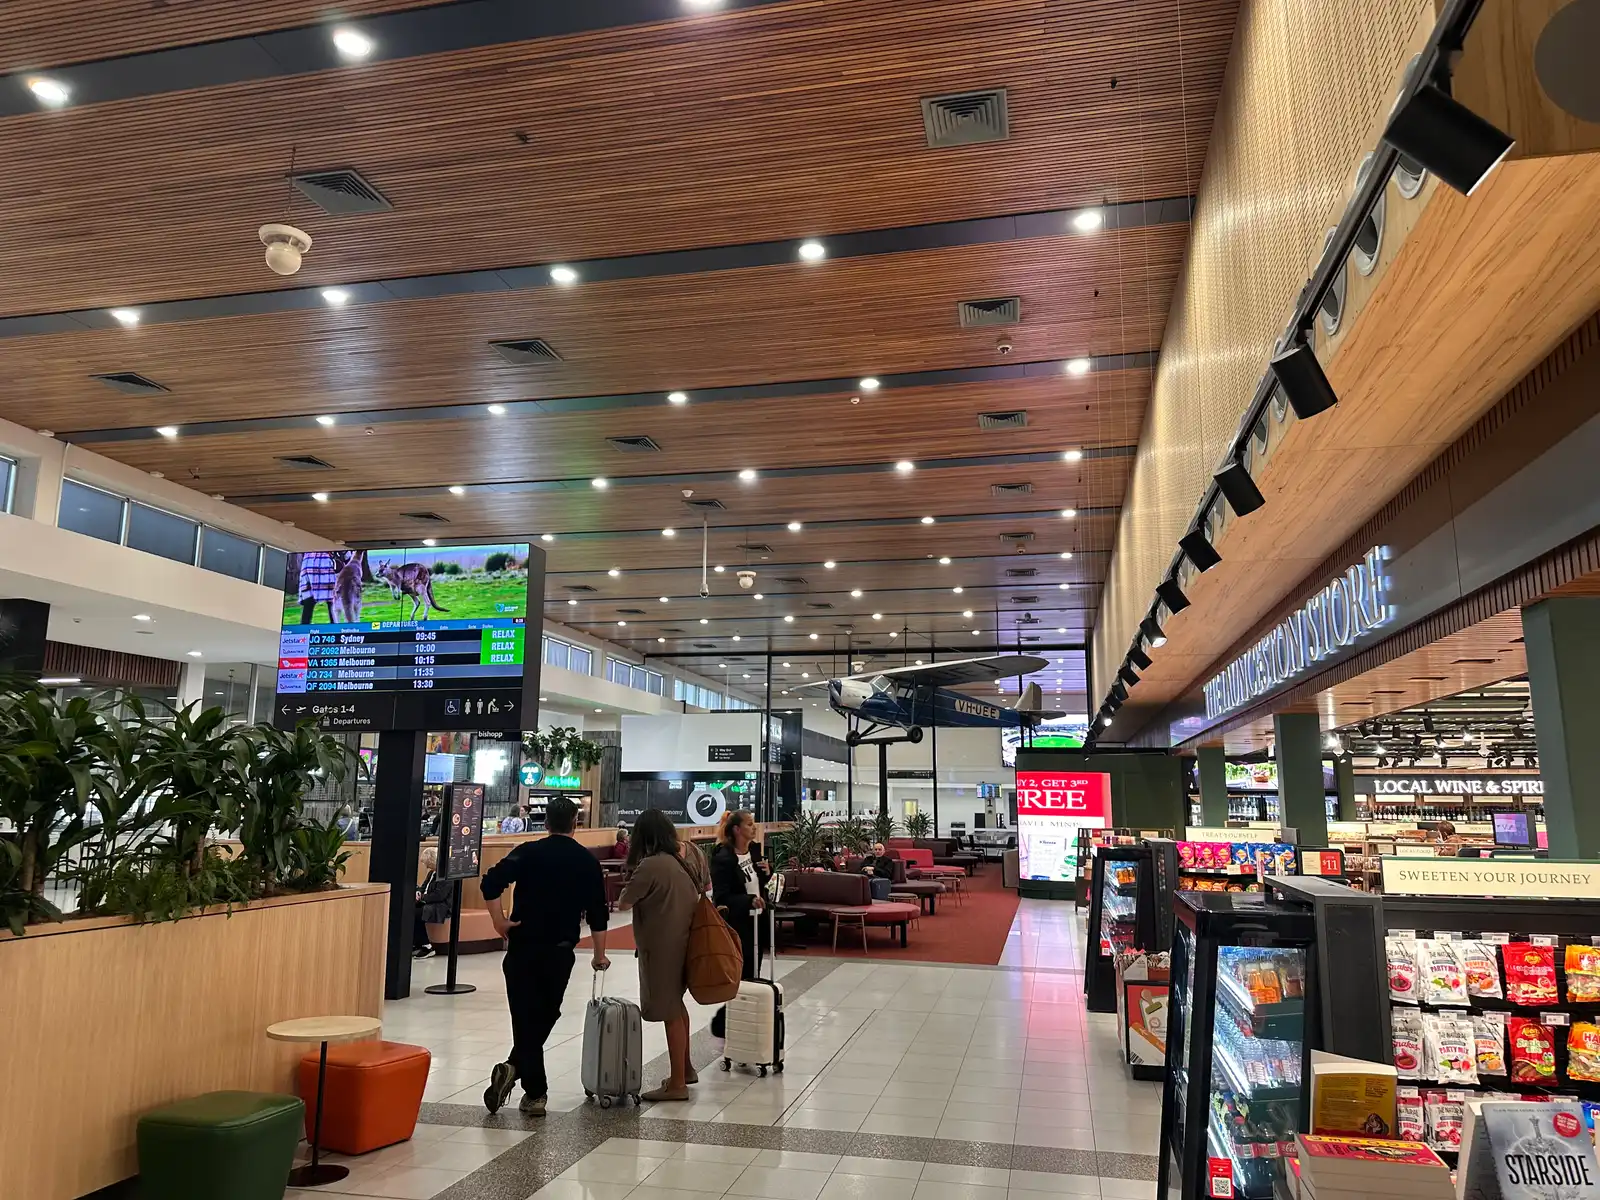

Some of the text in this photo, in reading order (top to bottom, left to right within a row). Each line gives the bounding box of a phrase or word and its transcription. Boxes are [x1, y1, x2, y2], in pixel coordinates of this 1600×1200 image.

[382, 620, 418, 628] DEPARTURES
[309, 636, 320, 644] JQ
[321, 635, 336, 643] 746
[340, 635, 365, 644] Sydney
[415, 632, 437, 641] 09:45
[492, 630, 515, 638] RELAX
[1203, 546, 1386, 720] THE LAUNCESTON STORE
[308, 647, 320, 655] QF
[321, 647, 339, 655] 2092
[339, 646, 376, 654] Melbourne
[415, 644, 436, 652] 10:00
[491, 642, 515, 650] RELAX
[308, 659, 319, 667] VA
[338, 658, 375, 666] Melbourne
[414, 656, 435, 664] 10:15
[491, 654, 514, 662] RELAX
[306, 671, 317, 679] JQ
[319, 670, 333, 678] 734
[338, 670, 375, 678] Melbourne
[413, 668, 434, 676] 11:35
[307, 683, 317, 691] QF
[318, 682, 337, 690] 2094
[337, 682, 374, 690] Melbourne
[412, 680, 433, 688] 13:30
[340, 704, 355, 714] 1-4
[333, 717, 371, 726] Departures
[478, 730, 503, 739] bishopp
[1029, 779, 1038, 788] 2,
[1041, 779, 1067, 787] GET
[1070, 779, 1089, 788] 3RD
[1374, 779, 1433, 794] LOCAL
[1434, 779, 1483, 794] WINE
[1485, 780, 1500, 794] &
[1322, 859, 1338, 870] $11
[1399, 869, 1592, 885] SWEETEN YOUR JOURNEY
[1430, 964, 1448, 972] PARTY
[1516, 1038, 1549, 1048] Snakes
[1439, 1046, 1457, 1054] PARTY
[1505, 1154, 1594, 1186] STARSIDE
